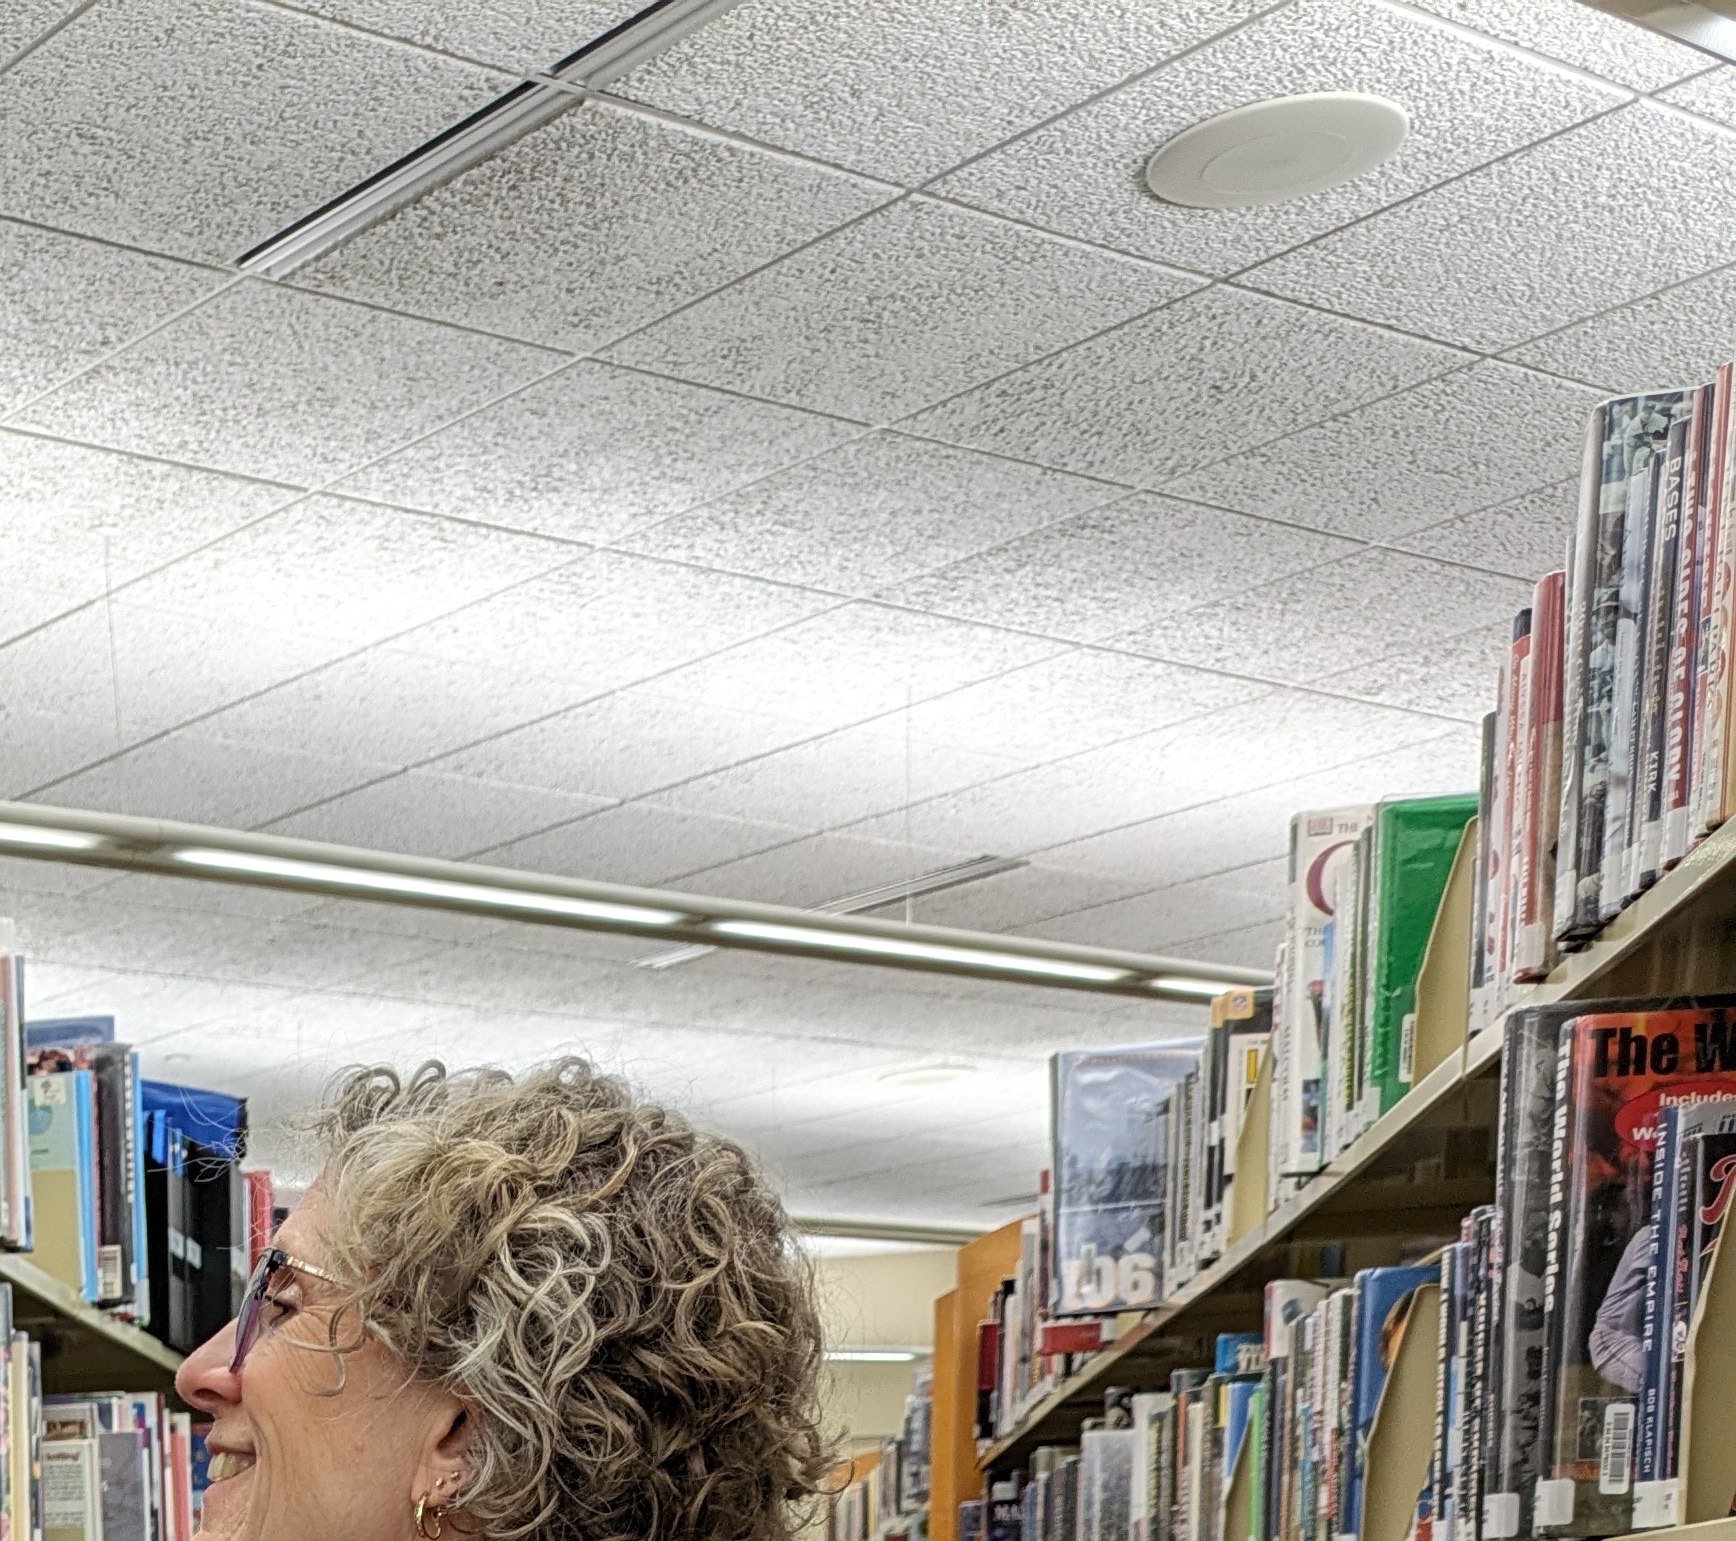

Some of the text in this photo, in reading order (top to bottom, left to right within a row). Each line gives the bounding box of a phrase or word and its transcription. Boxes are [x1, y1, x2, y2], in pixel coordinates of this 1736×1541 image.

[1663, 457, 1682, 542] BASES
[1589, 1027, 1680, 1078] The
[1660, 1093, 1736, 1106] Include
[1543, 1038, 1572, 1314] The World Series
[1642, 1123, 1668, 1353] INSIDE THE EMPIRE
